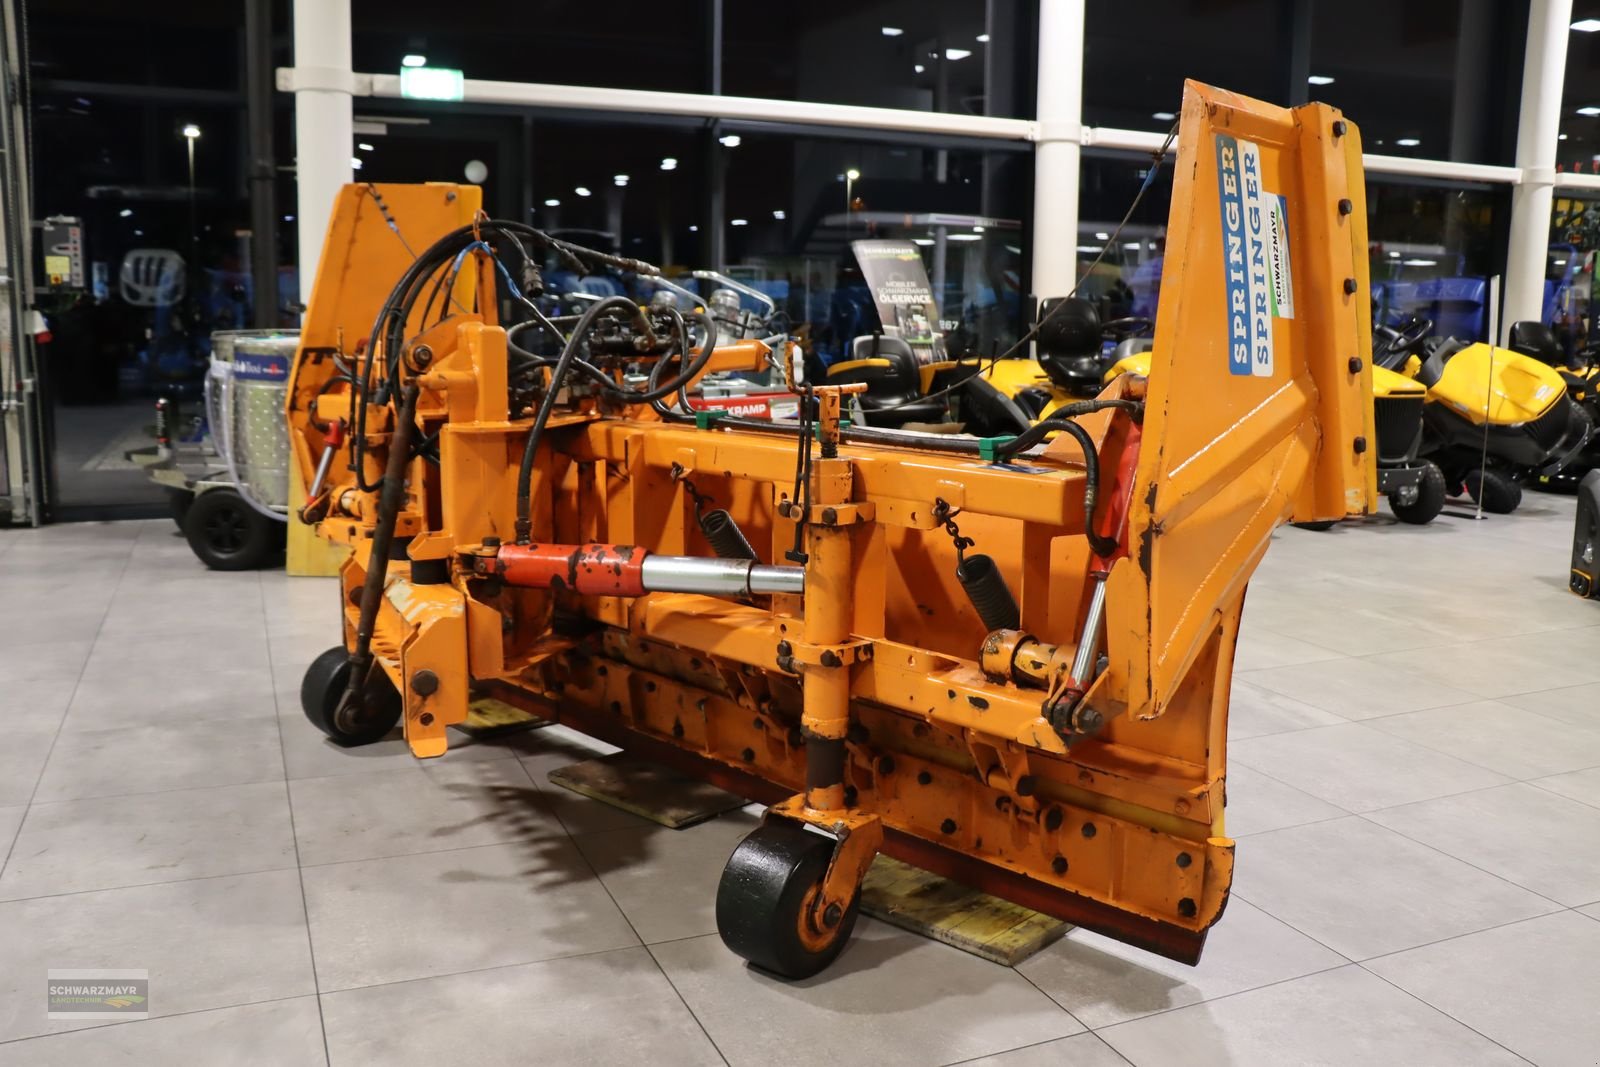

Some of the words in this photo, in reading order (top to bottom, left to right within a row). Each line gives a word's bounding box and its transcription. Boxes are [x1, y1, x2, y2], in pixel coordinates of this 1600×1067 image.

[1222, 146, 1248, 364] SPRINGER
[1244, 152, 1269, 365] SPRINGER
[1270, 210, 1283, 305] SCHWARZMAYR
[727, 403, 767, 416] KRAMP
